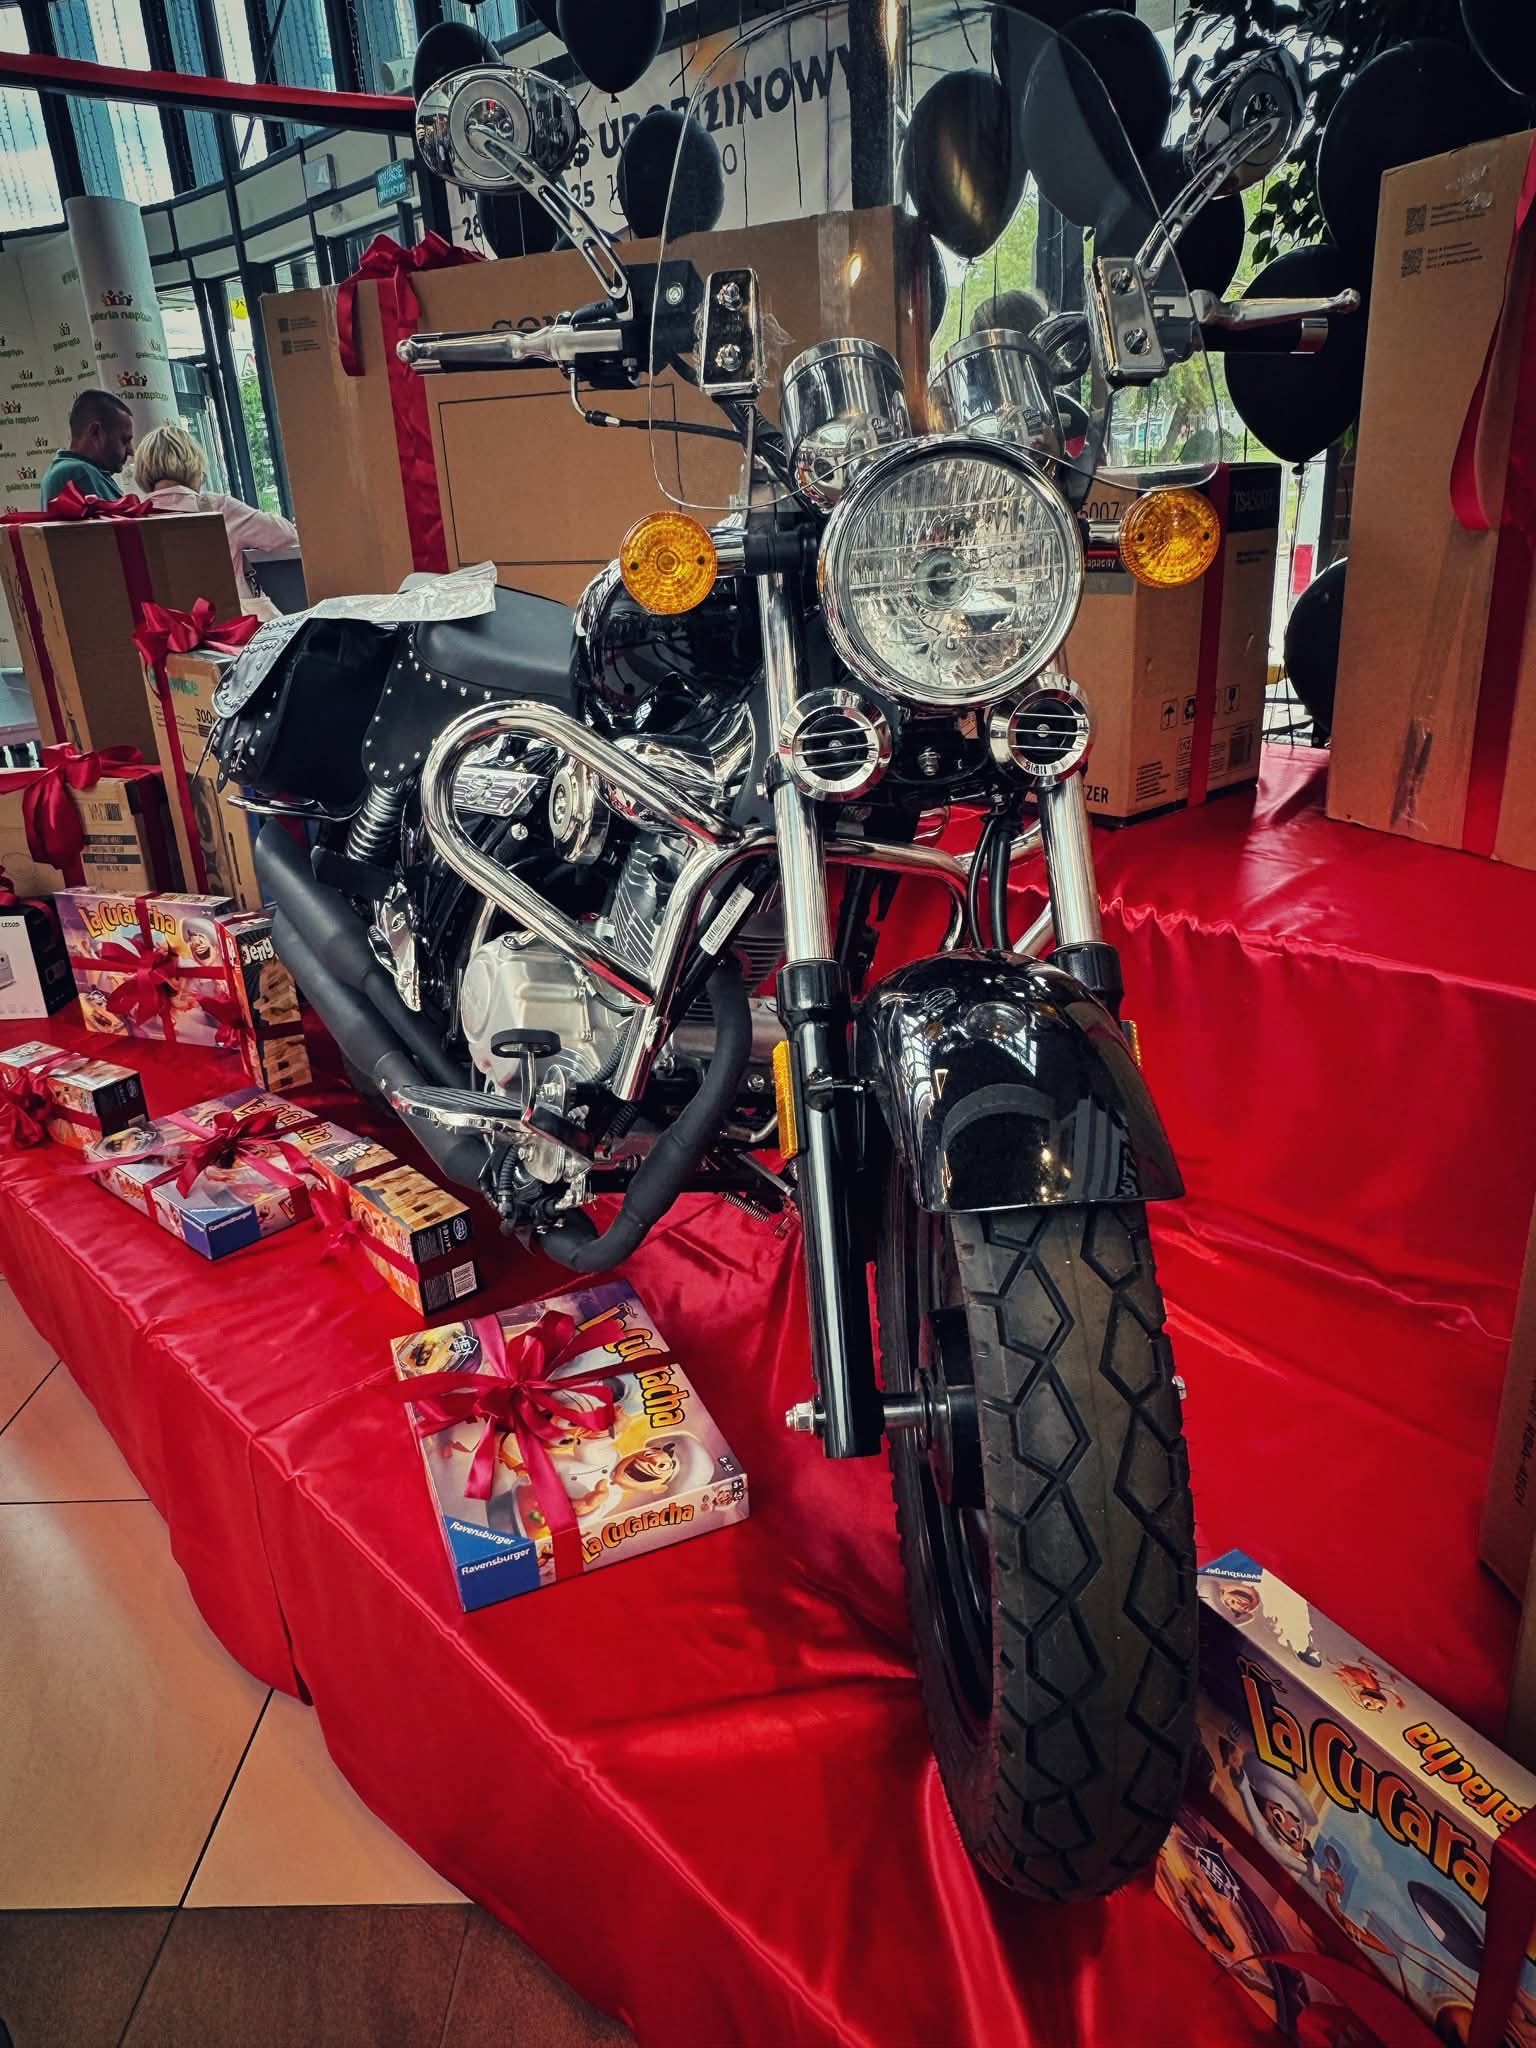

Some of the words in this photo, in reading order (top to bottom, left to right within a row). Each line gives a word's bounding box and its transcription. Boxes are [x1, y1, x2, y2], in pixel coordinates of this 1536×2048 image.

[79, 906, 102, 938] La
[241, 936, 277, 966] Jeng
[323, 1142, 370, 1167] Jenga
[451, 1520, 515, 1546] Ravensburger
[601, 1502, 695, 1548] Cucaracha
[461, 1548, 531, 1575] Ravensburger
[1241, 1674, 1307, 1778] La
